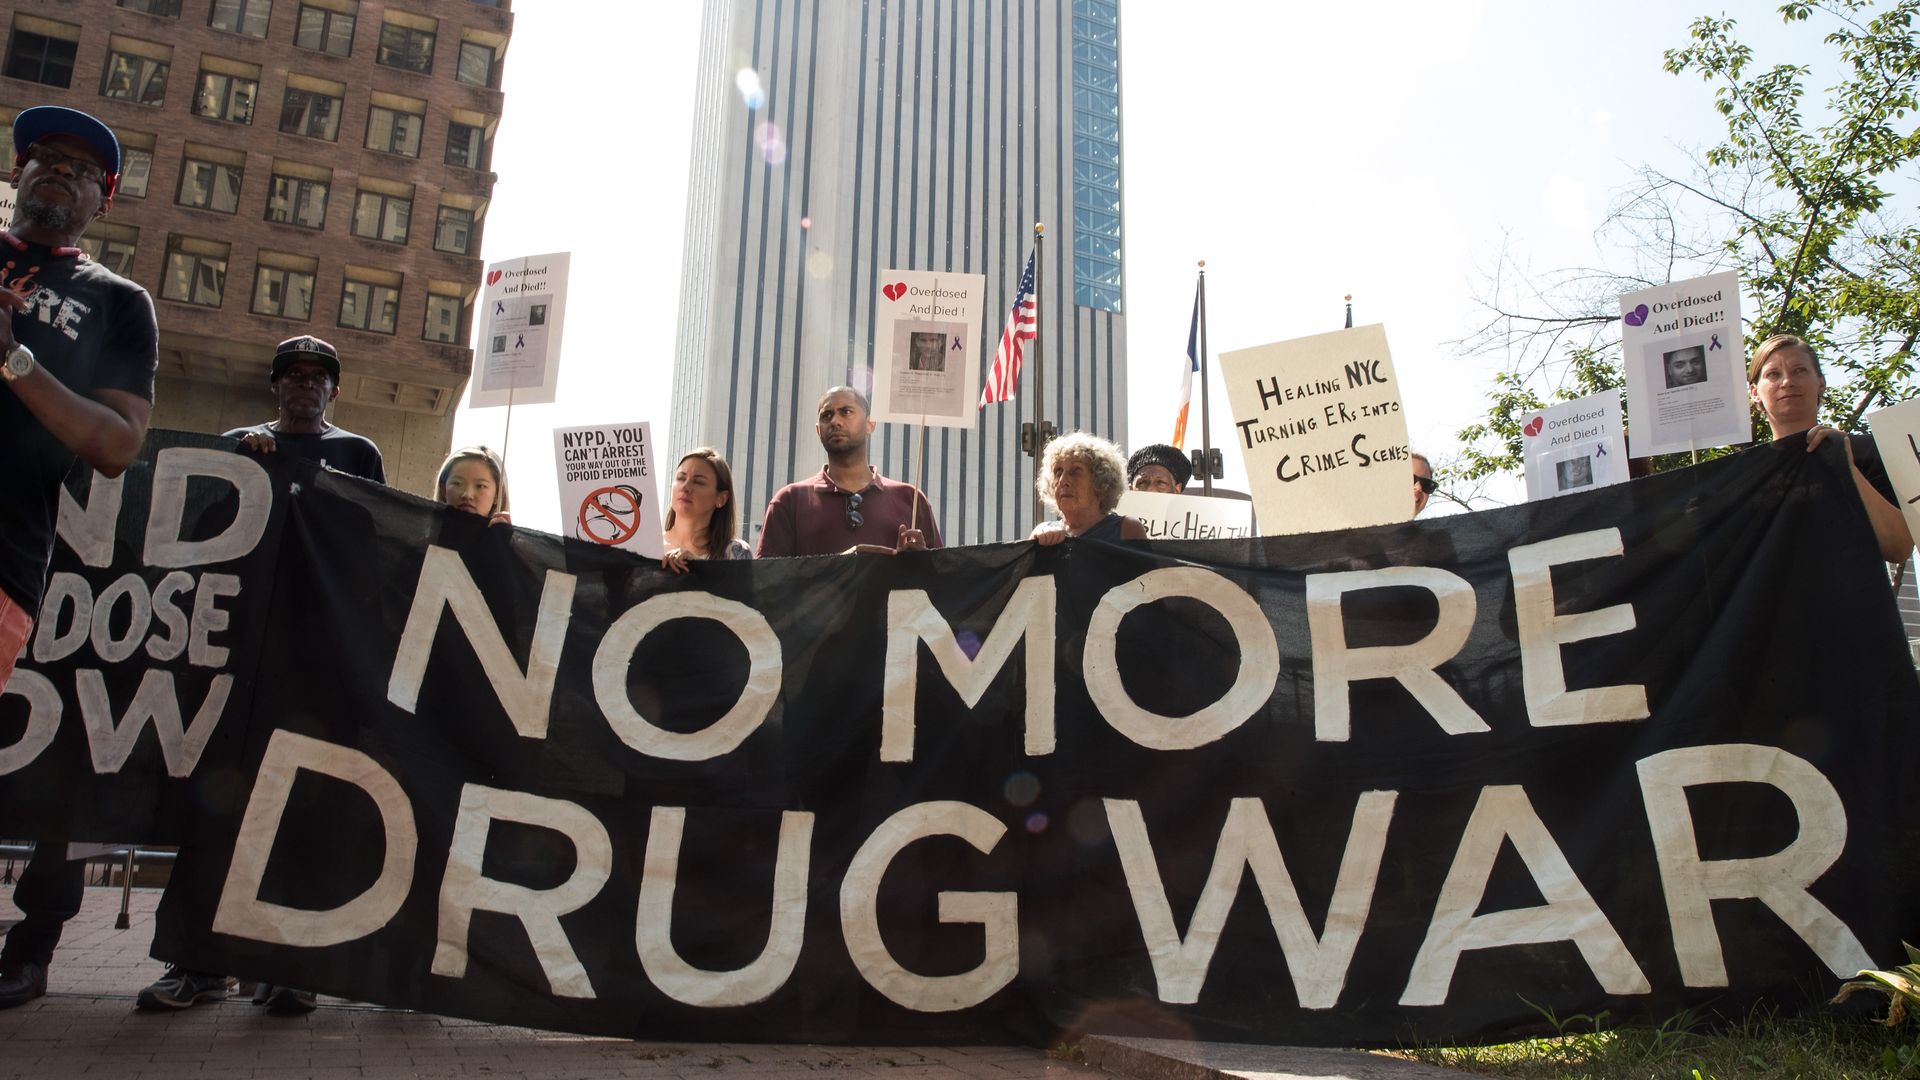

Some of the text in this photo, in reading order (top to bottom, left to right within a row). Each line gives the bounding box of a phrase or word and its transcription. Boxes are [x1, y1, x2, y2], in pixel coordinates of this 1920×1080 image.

[504, 266, 548, 279] Overdosed
[502, 281, 546, 294] And Died!!
[910, 286, 968, 299] Overdosed
[909, 304, 931, 315] And
[1652, 290, 1722, 314] Overdosed
[1653, 310, 1725, 335] And Died!!
[1344, 359, 1388, 389] NYC
[1361, 401, 1399, 417] INTO
[1548, 408, 1605, 430] Overdosed
[563, 428, 643, 448] NYPD, YOU
[1550, 433, 1571, 446] And
[564, 444, 645, 462] CAN'T ARREST
[1276, 433, 1409, 483] CRIME SCENES
[565, 457, 646, 472] YOUR WAY OUT OF THE
[566, 466, 648, 482] OPIOID EPIDEMIC
[17, 571, 243, 668] DOSE
[387, 527, 1651, 763] NO MORE
[212, 728, 1879, 1013] DRUG WAR
